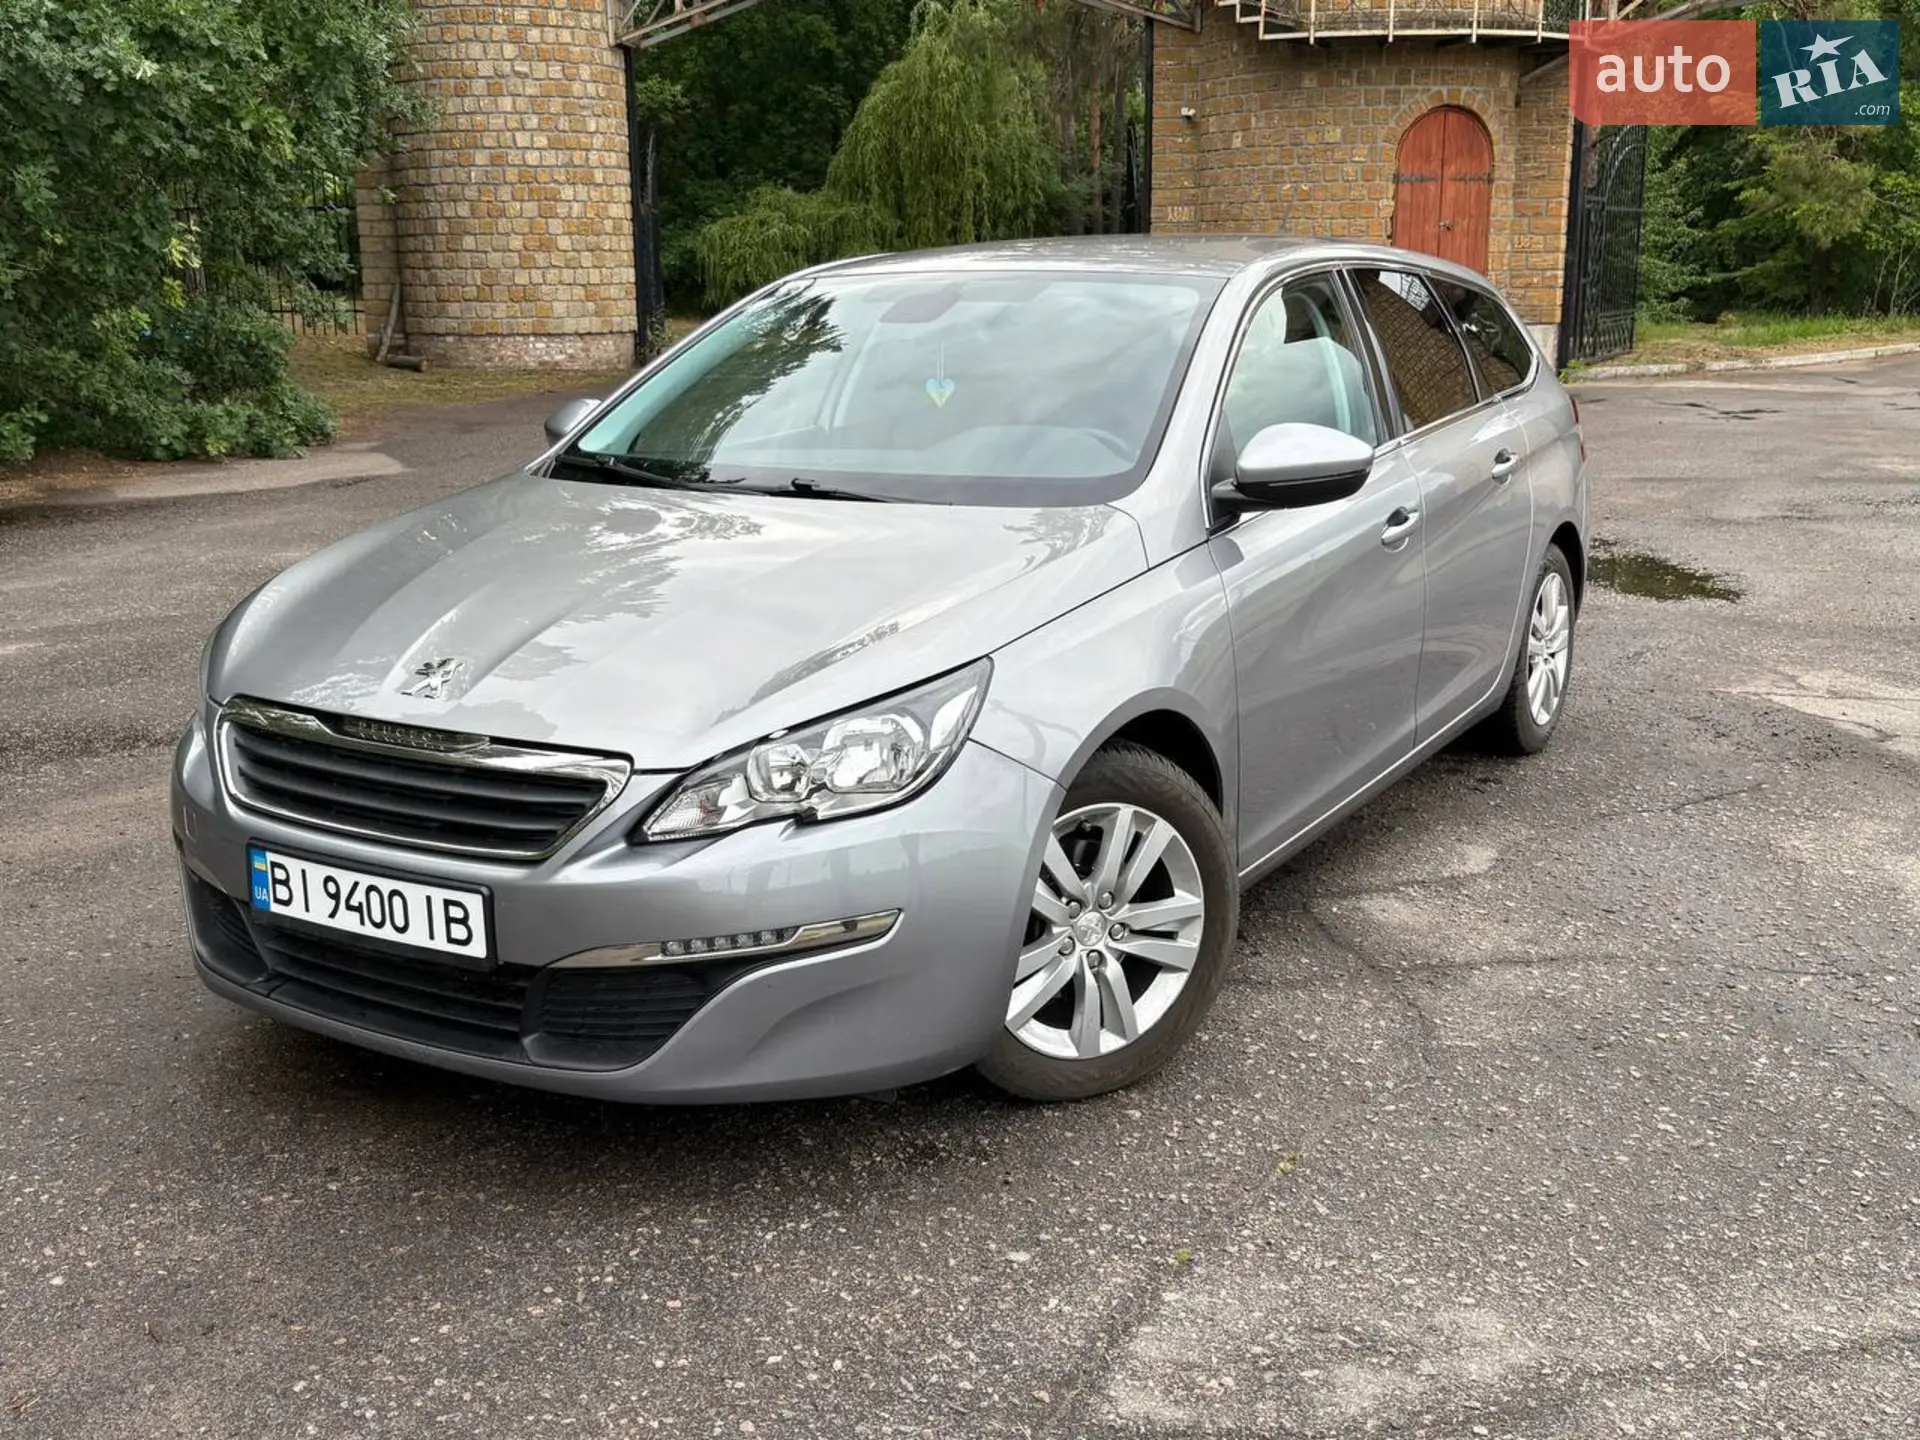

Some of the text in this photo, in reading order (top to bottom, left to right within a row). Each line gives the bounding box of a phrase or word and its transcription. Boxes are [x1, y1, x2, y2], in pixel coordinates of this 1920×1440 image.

[254, 885, 269, 902] UA
[269, 860, 474, 947] BI 9400 IB
